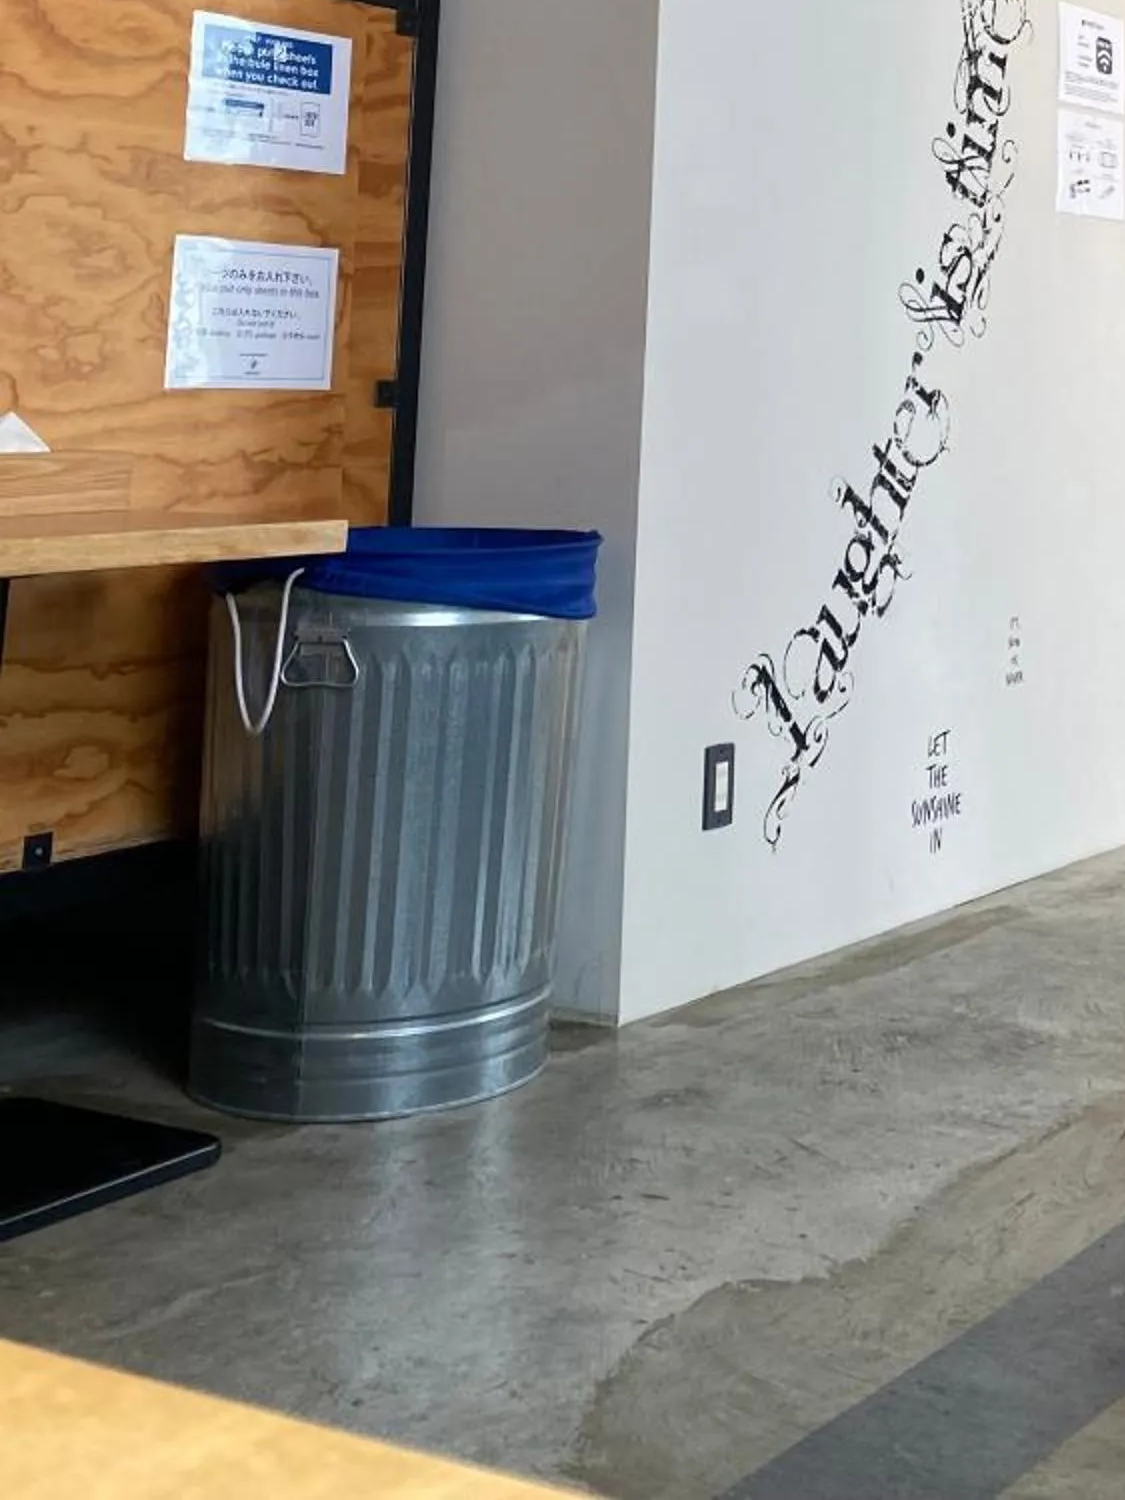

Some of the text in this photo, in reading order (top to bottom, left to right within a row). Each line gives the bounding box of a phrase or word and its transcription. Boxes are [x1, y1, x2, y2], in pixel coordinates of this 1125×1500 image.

[927, 729, 951, 757] LET
[926, 763, 948, 789] THE
[929, 828, 943, 853] IN
